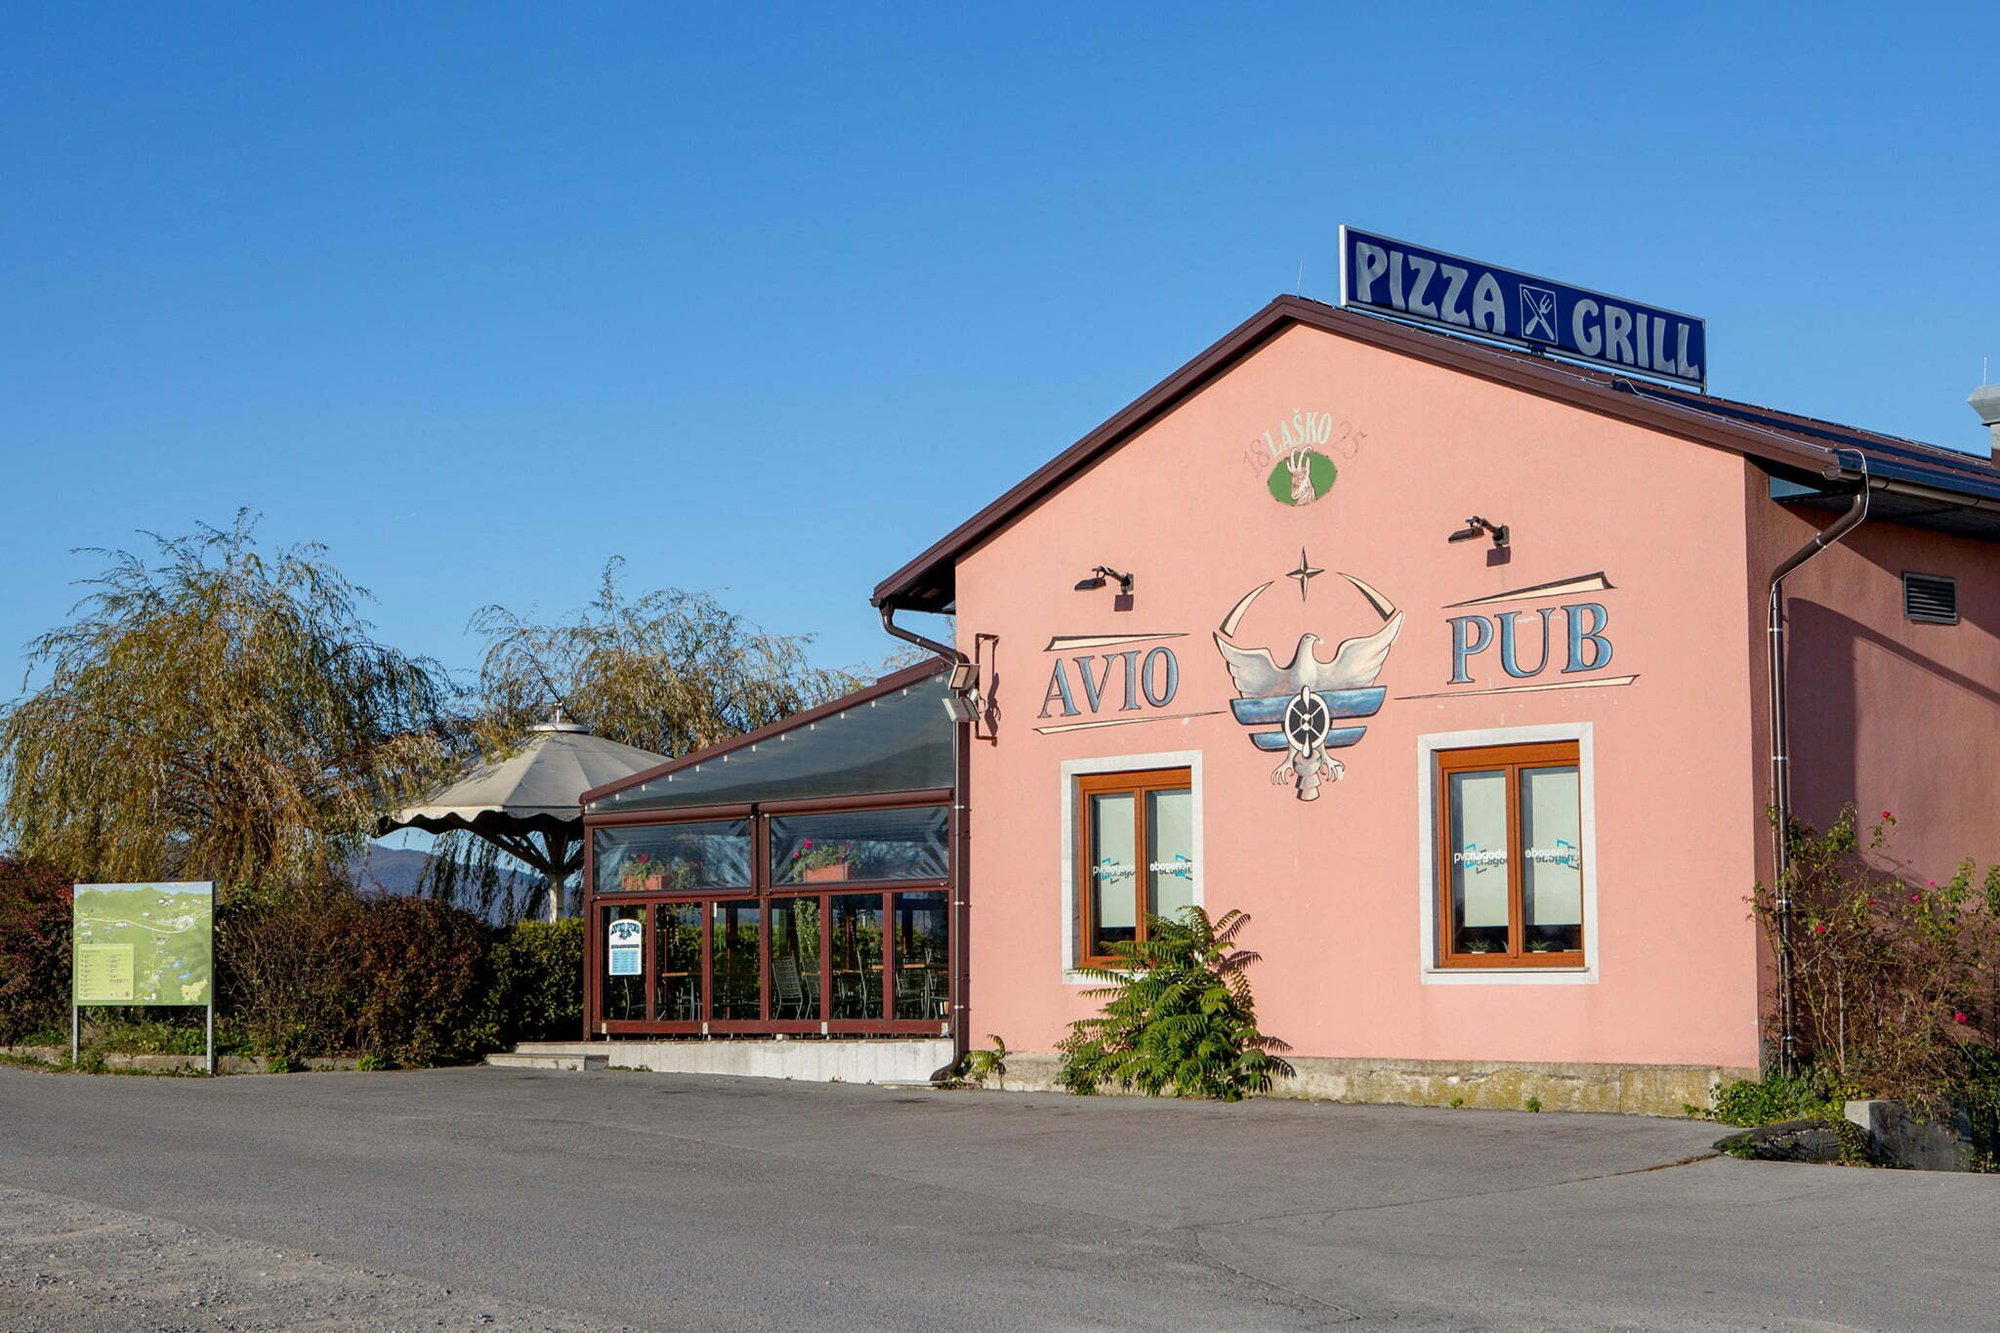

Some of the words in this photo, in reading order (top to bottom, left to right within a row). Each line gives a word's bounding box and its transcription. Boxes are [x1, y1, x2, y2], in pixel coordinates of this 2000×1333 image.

[1355, 241, 1506, 335] PIZZA
[1572, 299, 1701, 378] GRILL
[1264, 408, 1333, 457] LAŠKO
[1037, 646, 1179, 719] AVIO
[1446, 603, 1613, 685] PUB
